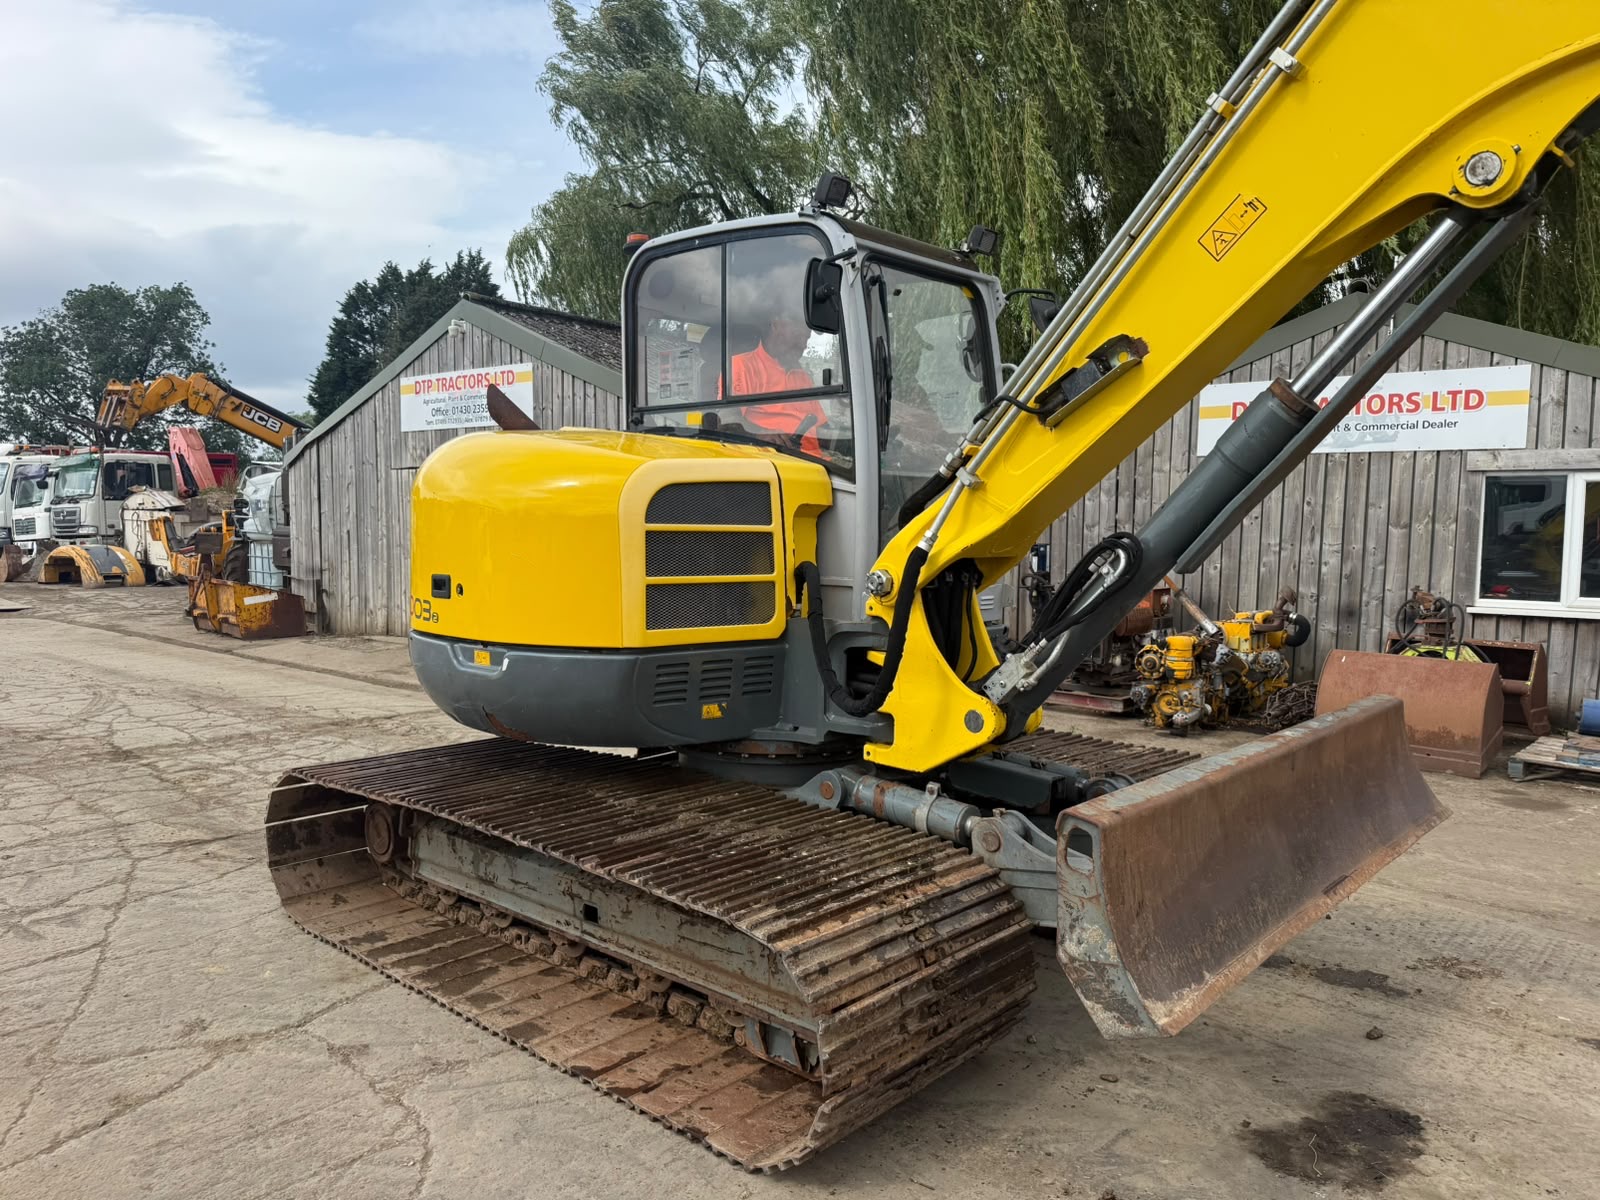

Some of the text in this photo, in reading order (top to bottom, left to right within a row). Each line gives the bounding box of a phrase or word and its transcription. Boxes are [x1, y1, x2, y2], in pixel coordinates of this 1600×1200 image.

[414, 370, 515, 395] DTP TRACTORS LTD
[431, 403, 489, 418] Office: 01430 2359
[1431, 389, 1485, 412] LTD
[242, 408, 281, 432] JCB
[1343, 423, 1351, 432] &
[1354, 420, 1419, 432] Commercial
[1422, 419, 1459, 429] Dealer
